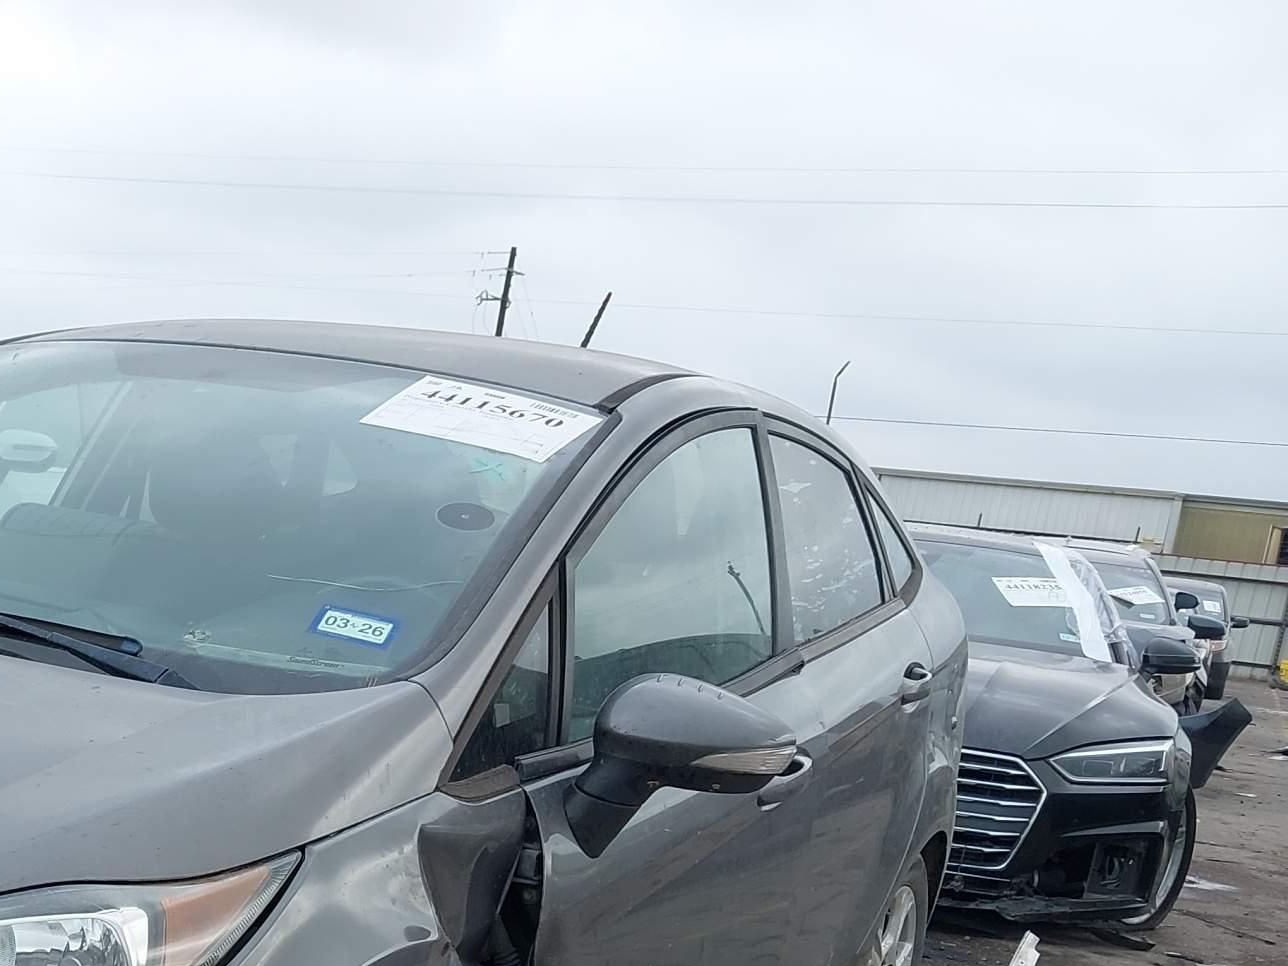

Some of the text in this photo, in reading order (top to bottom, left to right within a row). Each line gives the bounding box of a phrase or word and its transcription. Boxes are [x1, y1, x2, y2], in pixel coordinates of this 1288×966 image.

[420, 389, 565, 428] 44115670
[324, 615, 386, 638] 03 26
